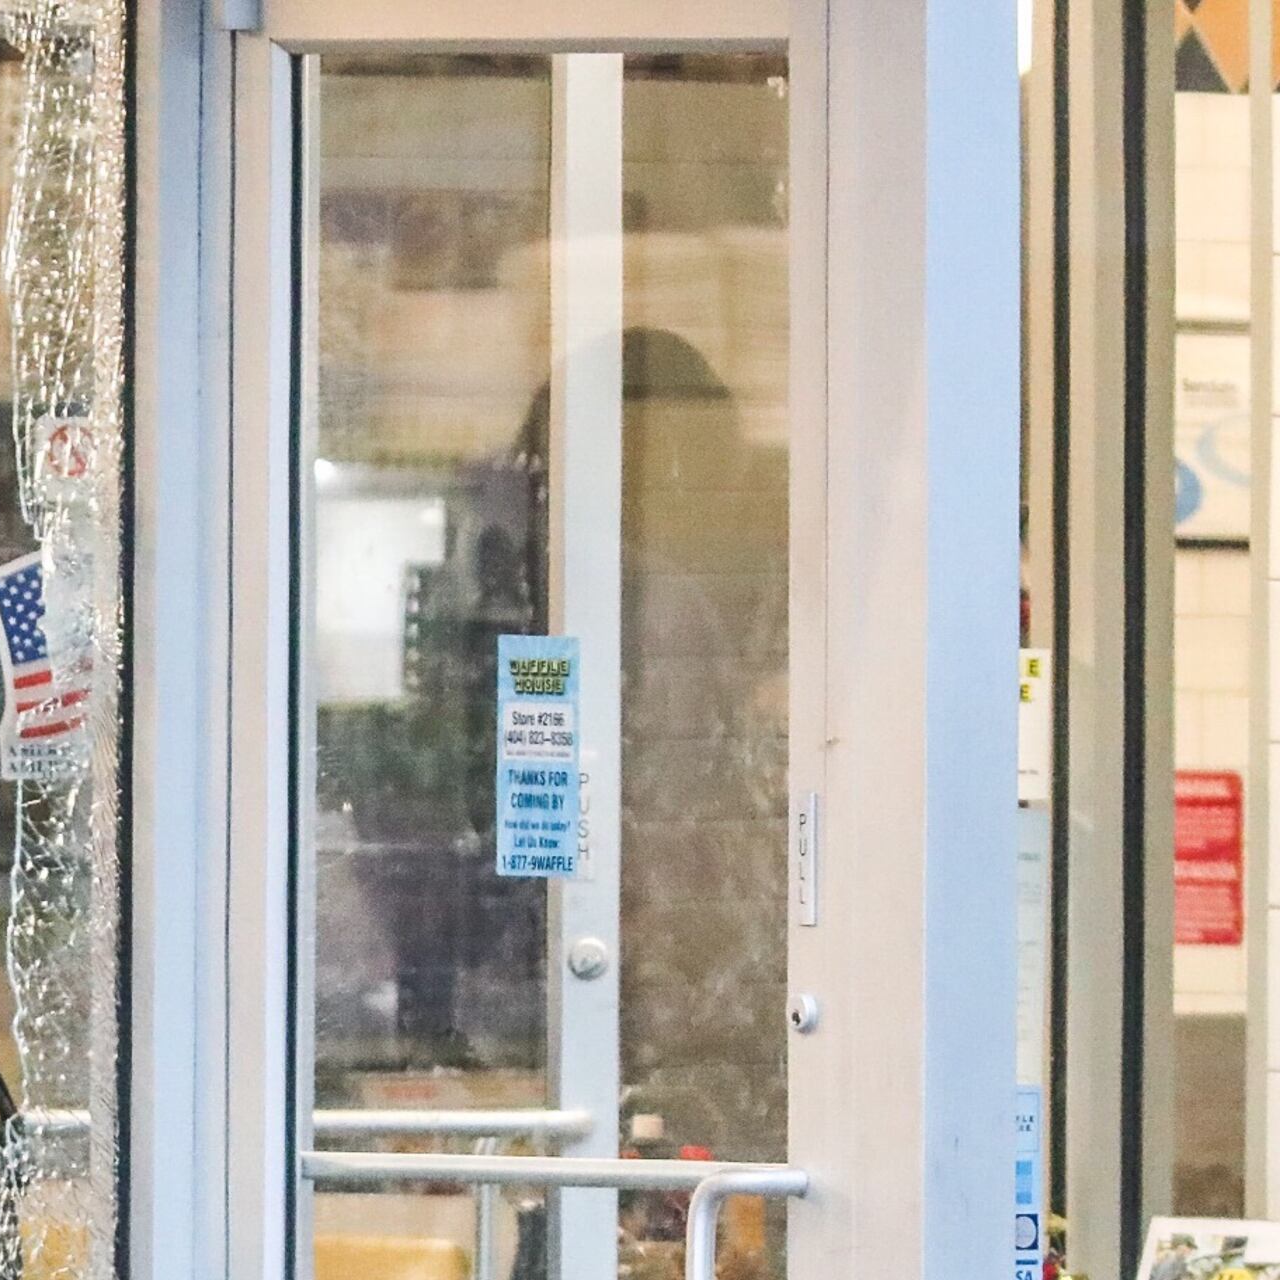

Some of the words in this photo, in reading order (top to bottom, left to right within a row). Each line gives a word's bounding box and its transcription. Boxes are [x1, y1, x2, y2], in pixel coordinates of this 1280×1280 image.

[510, 659, 568, 674] WAFFLE
[514, 678, 563, 692] HOUSE
[512, 711, 535, 726] Store
[508, 769, 546, 786] THANKS
[548, 771, 568, 787] FOR
[511, 792, 550, 810] COMING
[552, 794, 565, 811] BY
[502, 854, 574, 872] 1-877-9WAFFLE
